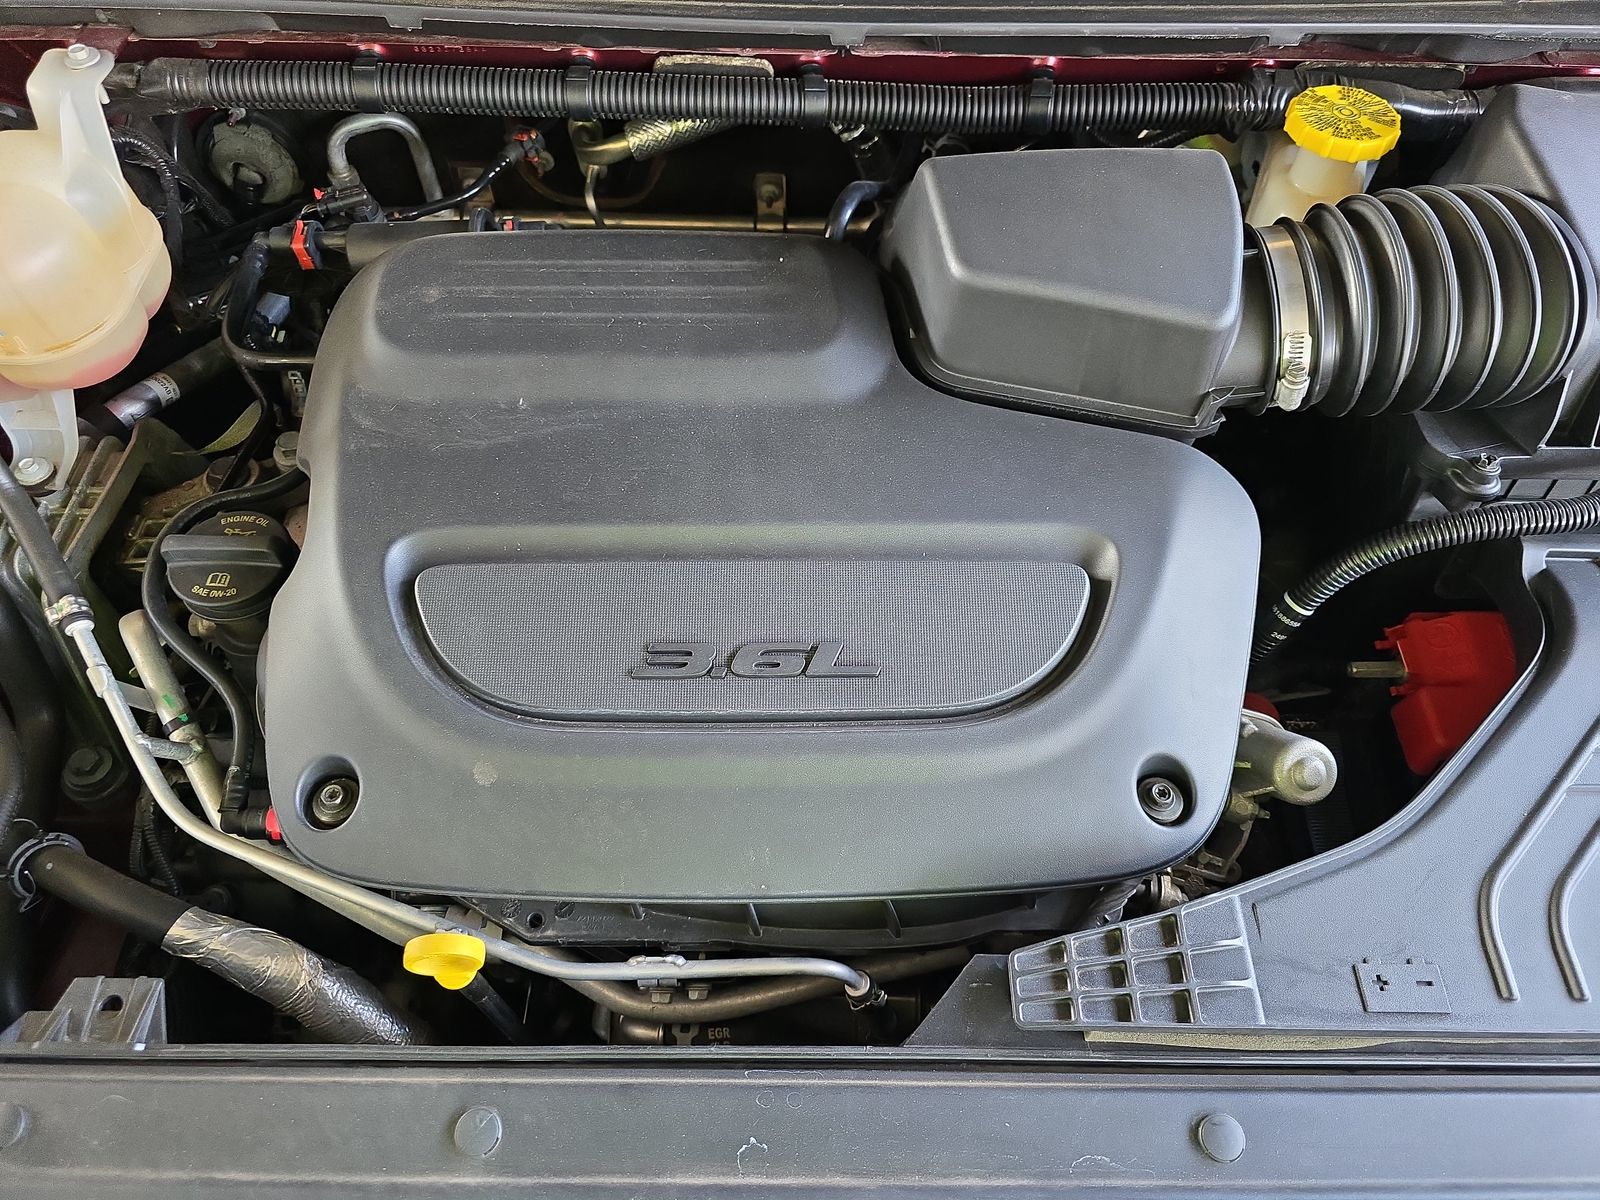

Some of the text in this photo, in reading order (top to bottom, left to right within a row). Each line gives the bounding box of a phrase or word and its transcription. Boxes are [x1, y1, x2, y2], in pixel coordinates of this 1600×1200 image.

[220, 515, 270, 527] ENGINE OIL
[191, 585, 237, 598] SAE 0W-20
[631, 642, 882, 679] 3.6L
[708, 1027, 731, 1040] EGR
